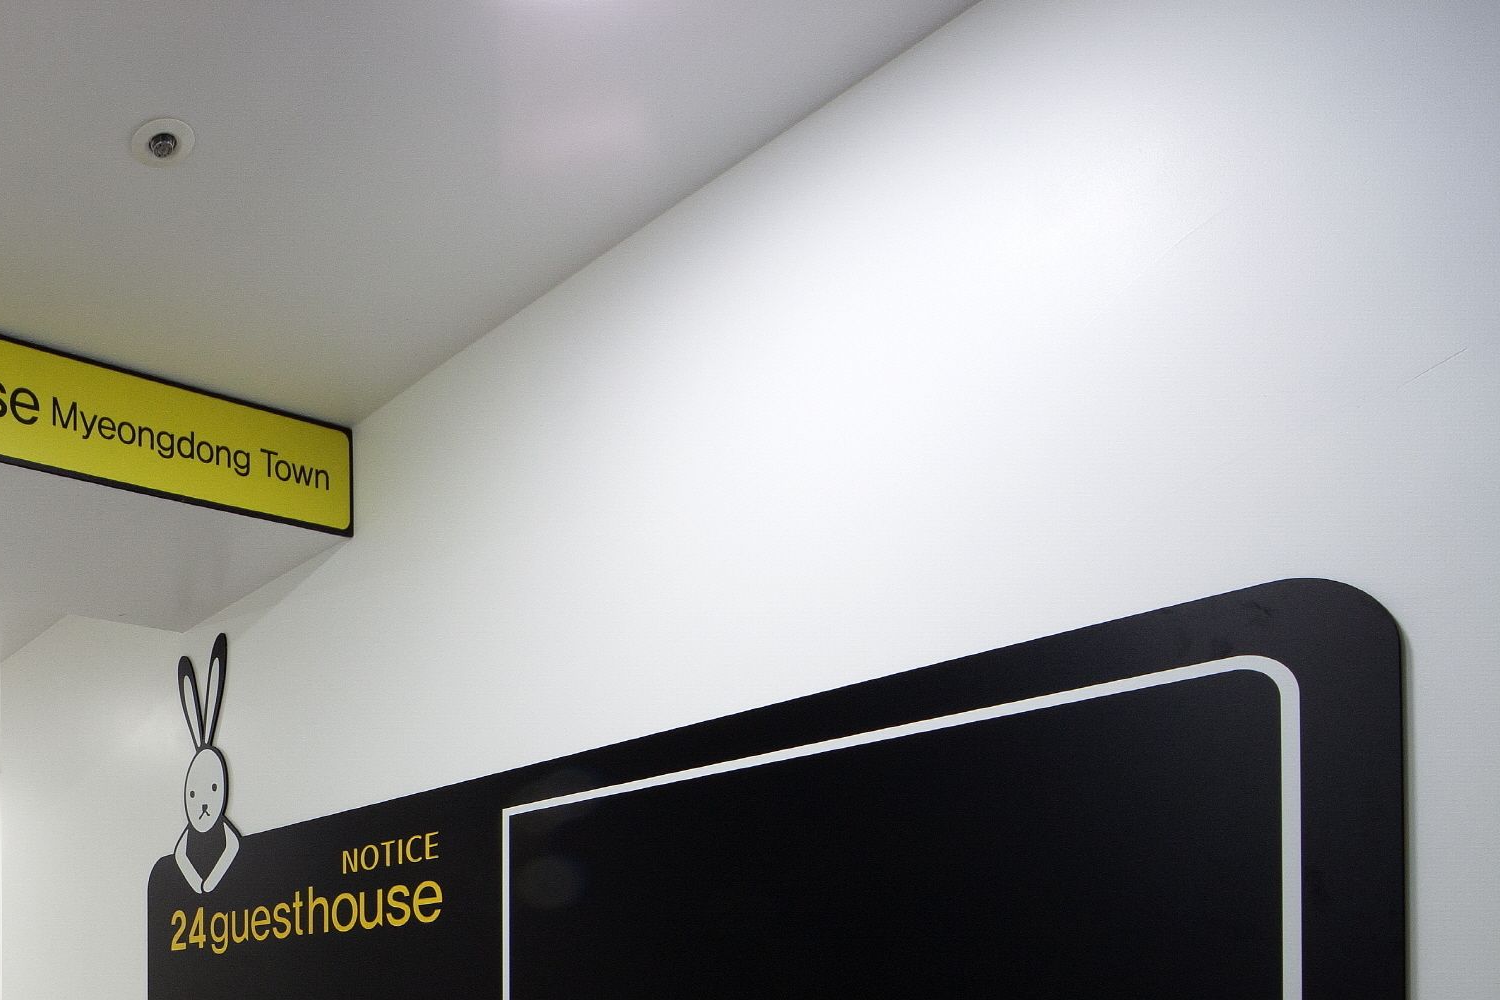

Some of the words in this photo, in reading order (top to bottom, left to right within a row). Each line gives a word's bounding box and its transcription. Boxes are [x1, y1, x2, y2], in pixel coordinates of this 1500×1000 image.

[52, 396, 251, 477] Myeongdong
[260, 448, 330, 491] Town
[342, 831, 440, 875] NOTICE
